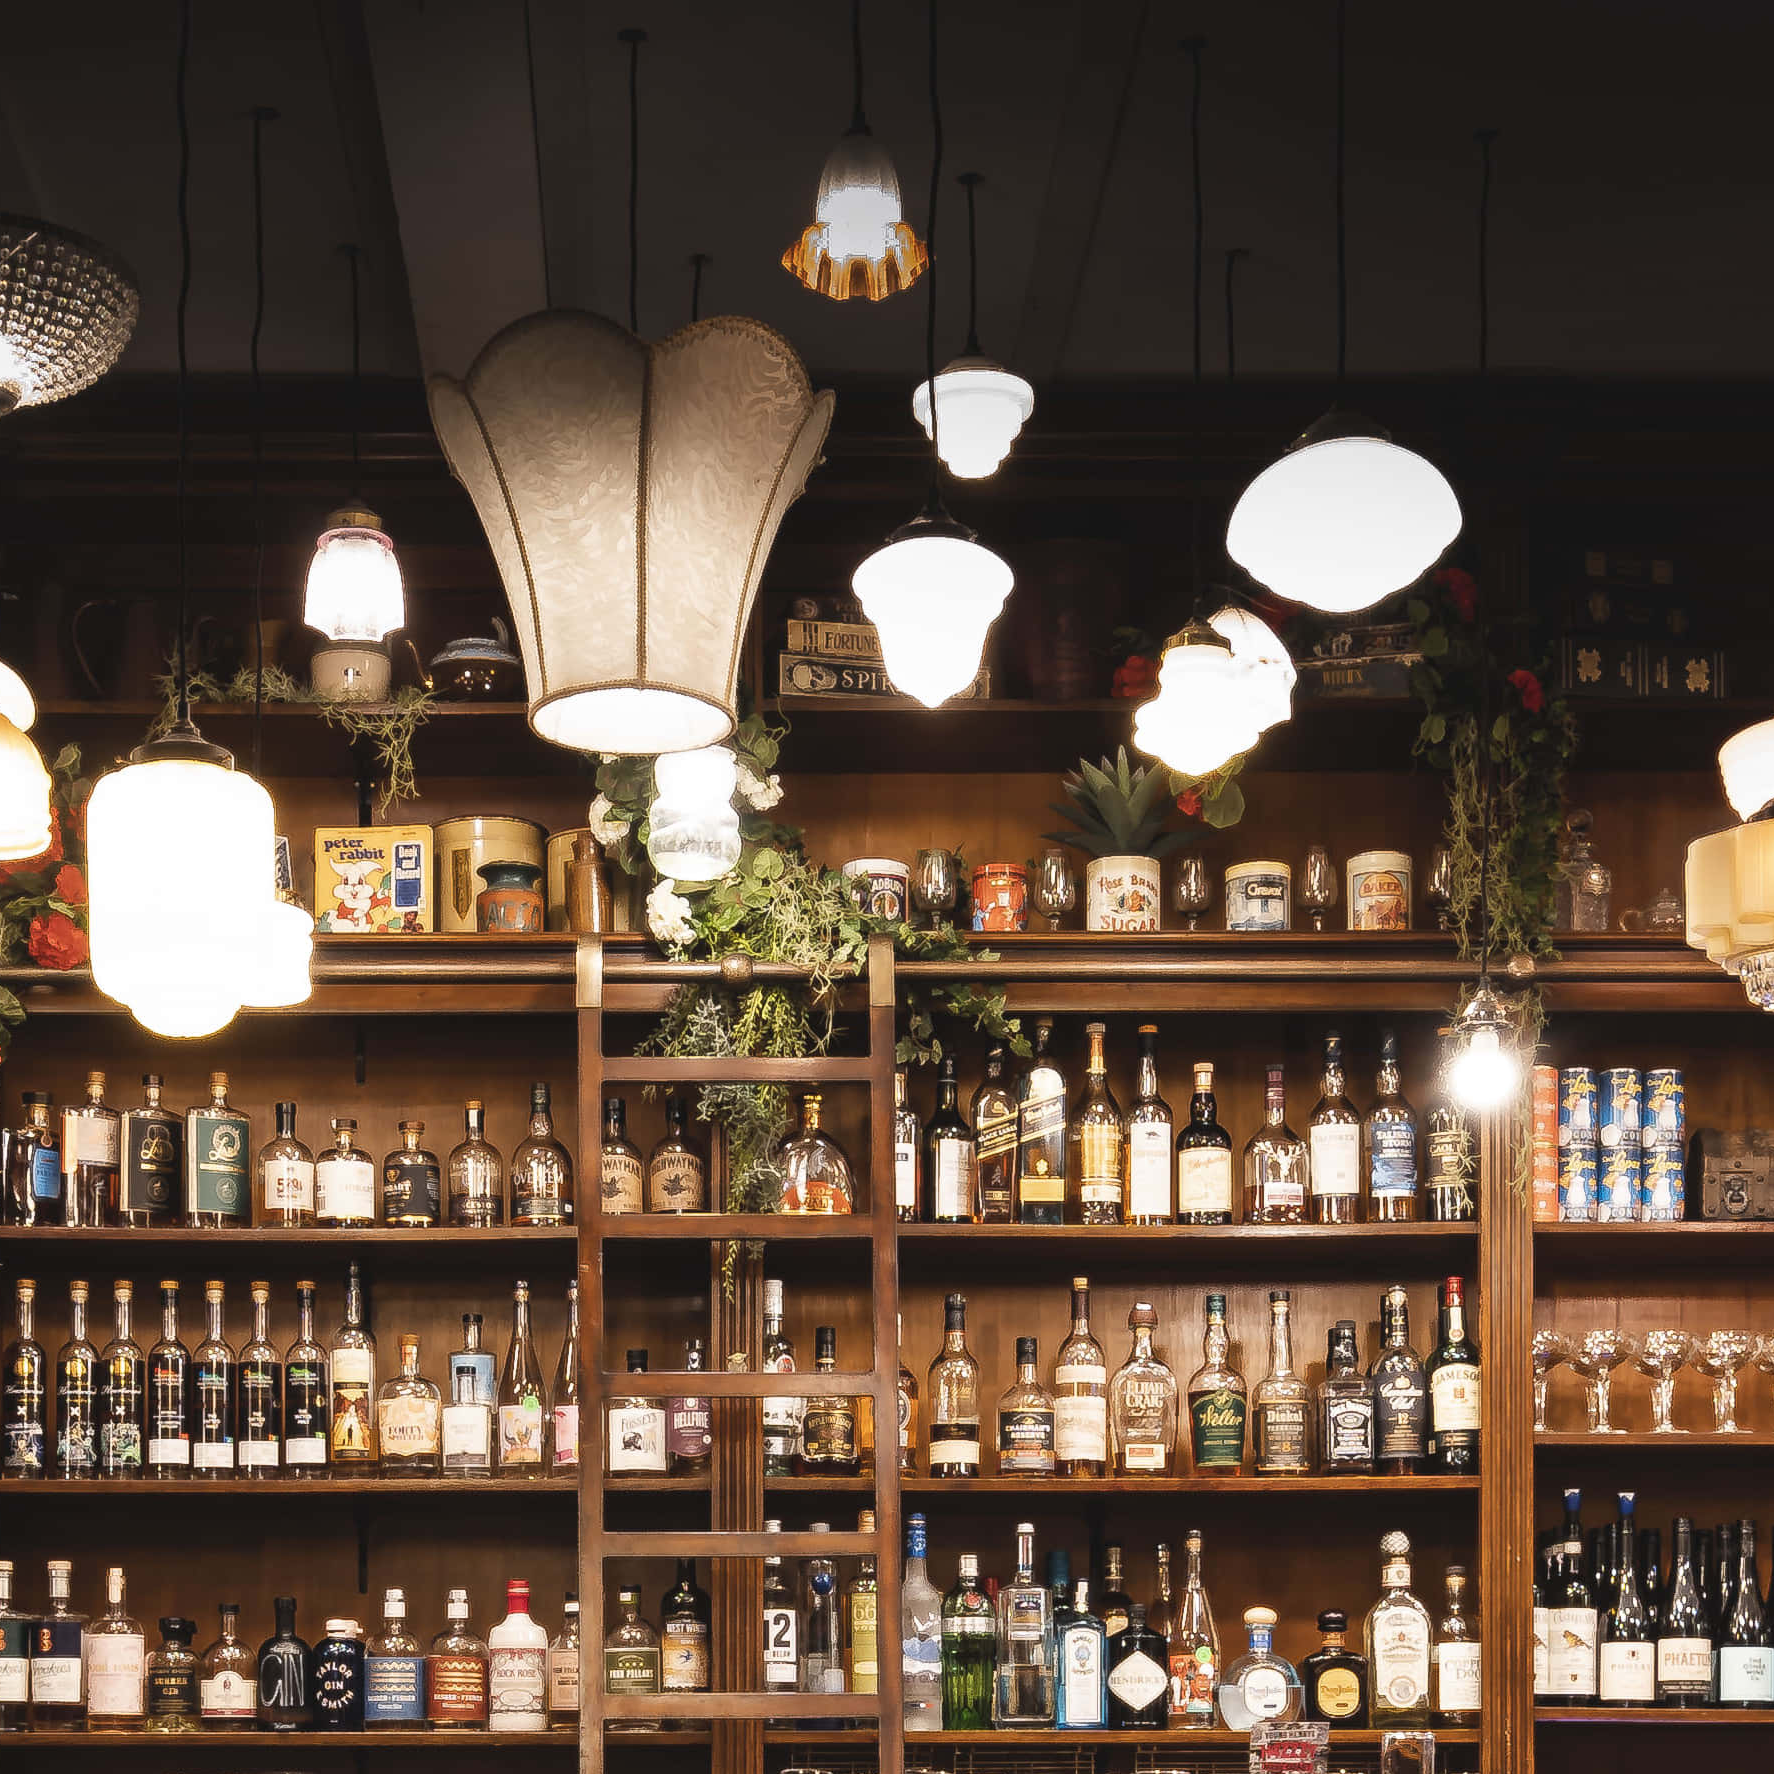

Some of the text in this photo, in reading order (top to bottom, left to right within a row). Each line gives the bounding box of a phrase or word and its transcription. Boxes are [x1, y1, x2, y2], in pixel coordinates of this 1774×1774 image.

[324, 838, 363, 851] peter
[339, 848, 385, 860] rabbit
[1100, 915, 1156, 932] SUGAR
[1126, 1380, 1164, 1394] ELIJAH
[1126, 1394, 1163, 1409] CRAIG
[1199, 1404, 1243, 1426] Weller
[316, 1661, 353, 1679] TAYLOR
[260, 1653, 305, 1707] GIN
[324, 1681, 344, 1690] GIN
[321, 1689, 354, 1709] SMITH
